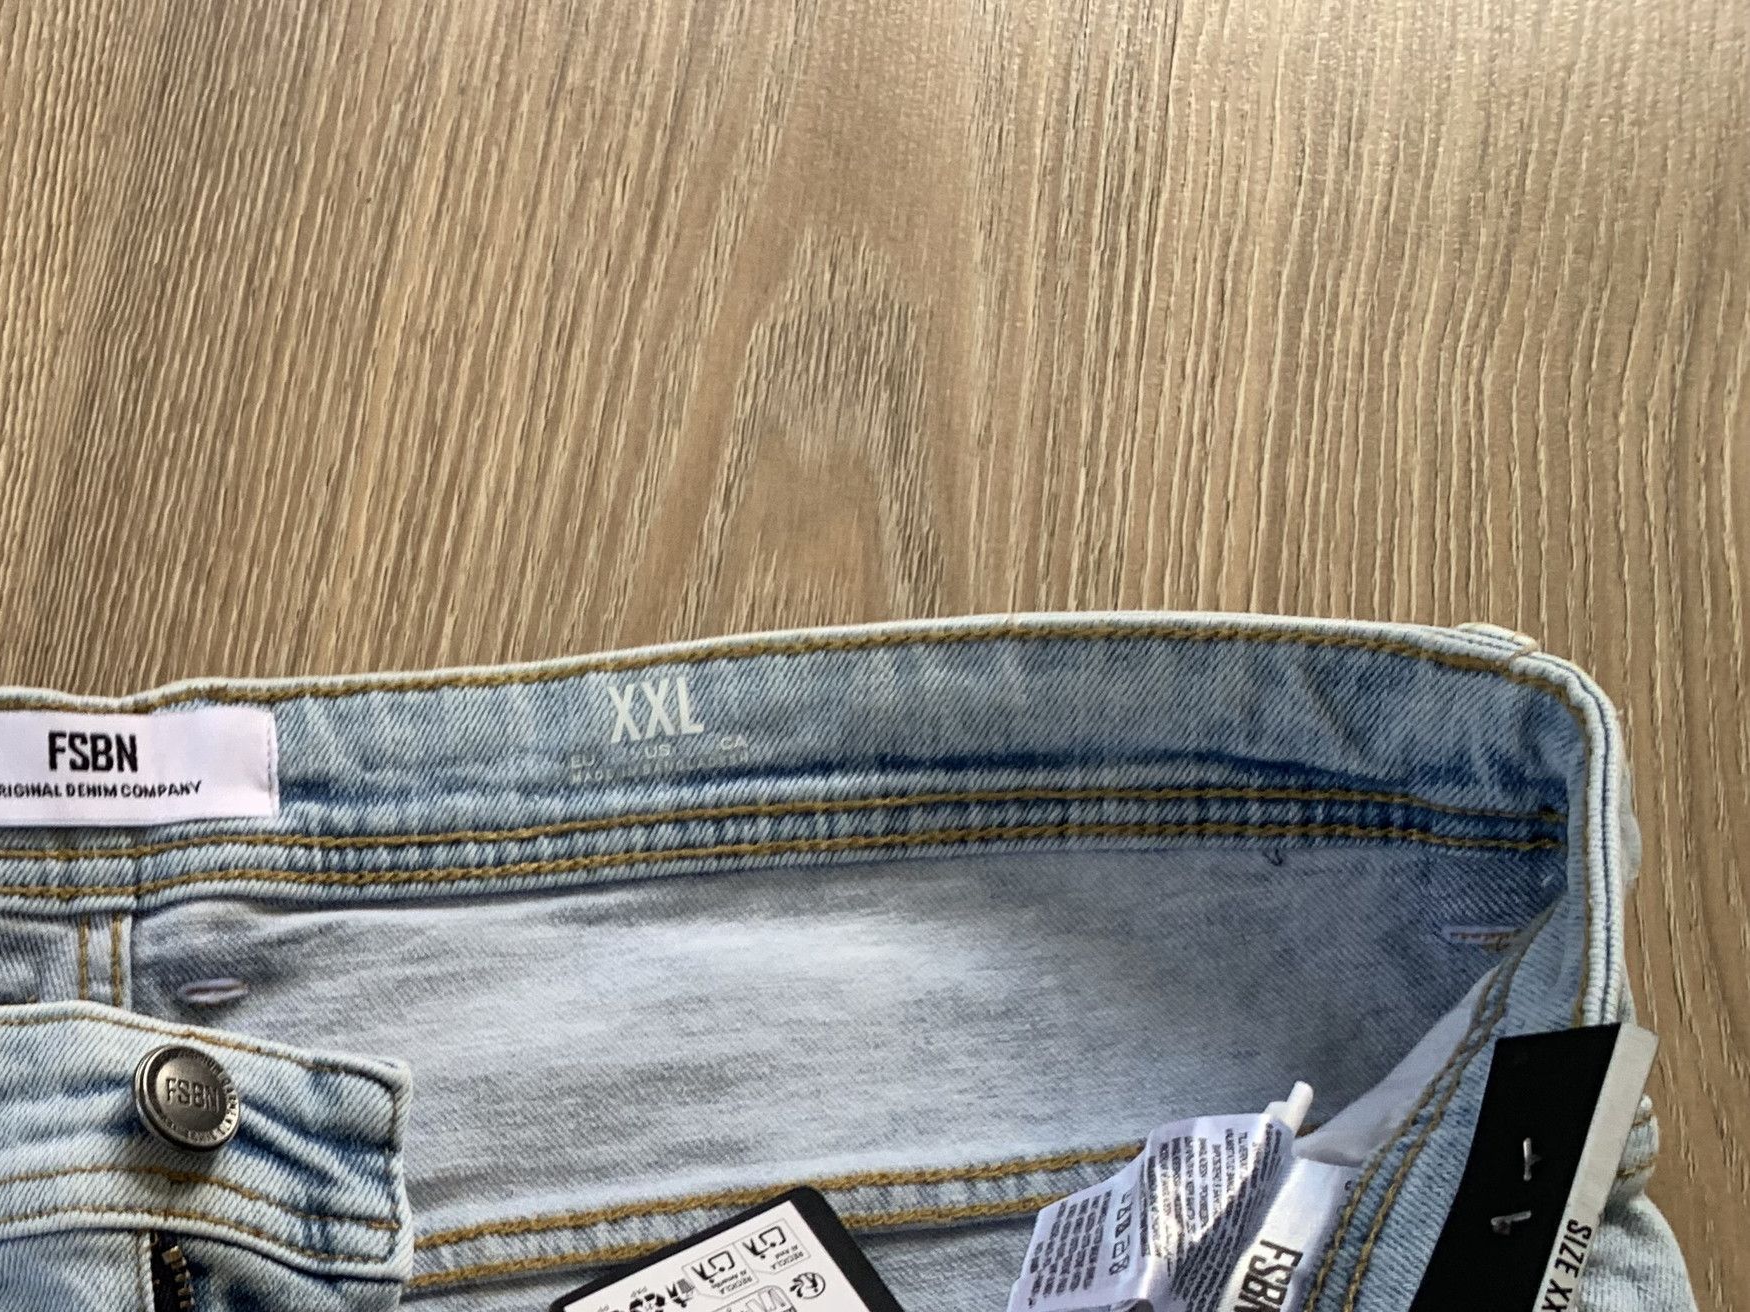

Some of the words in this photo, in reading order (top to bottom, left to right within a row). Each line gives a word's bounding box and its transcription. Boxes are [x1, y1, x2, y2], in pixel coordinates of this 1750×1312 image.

[607, 676, 705, 744] XXL
[48, 730, 139, 773] FSBN
[644, 744, 671, 759] US
[719, 734, 748, 751] CA
[66, 782, 118, 798] DENIM
[120, 780, 202, 799] COMPANY
[165, 1077, 220, 1113] FSBN
[1554, 1218, 1593, 1279] SIZE
